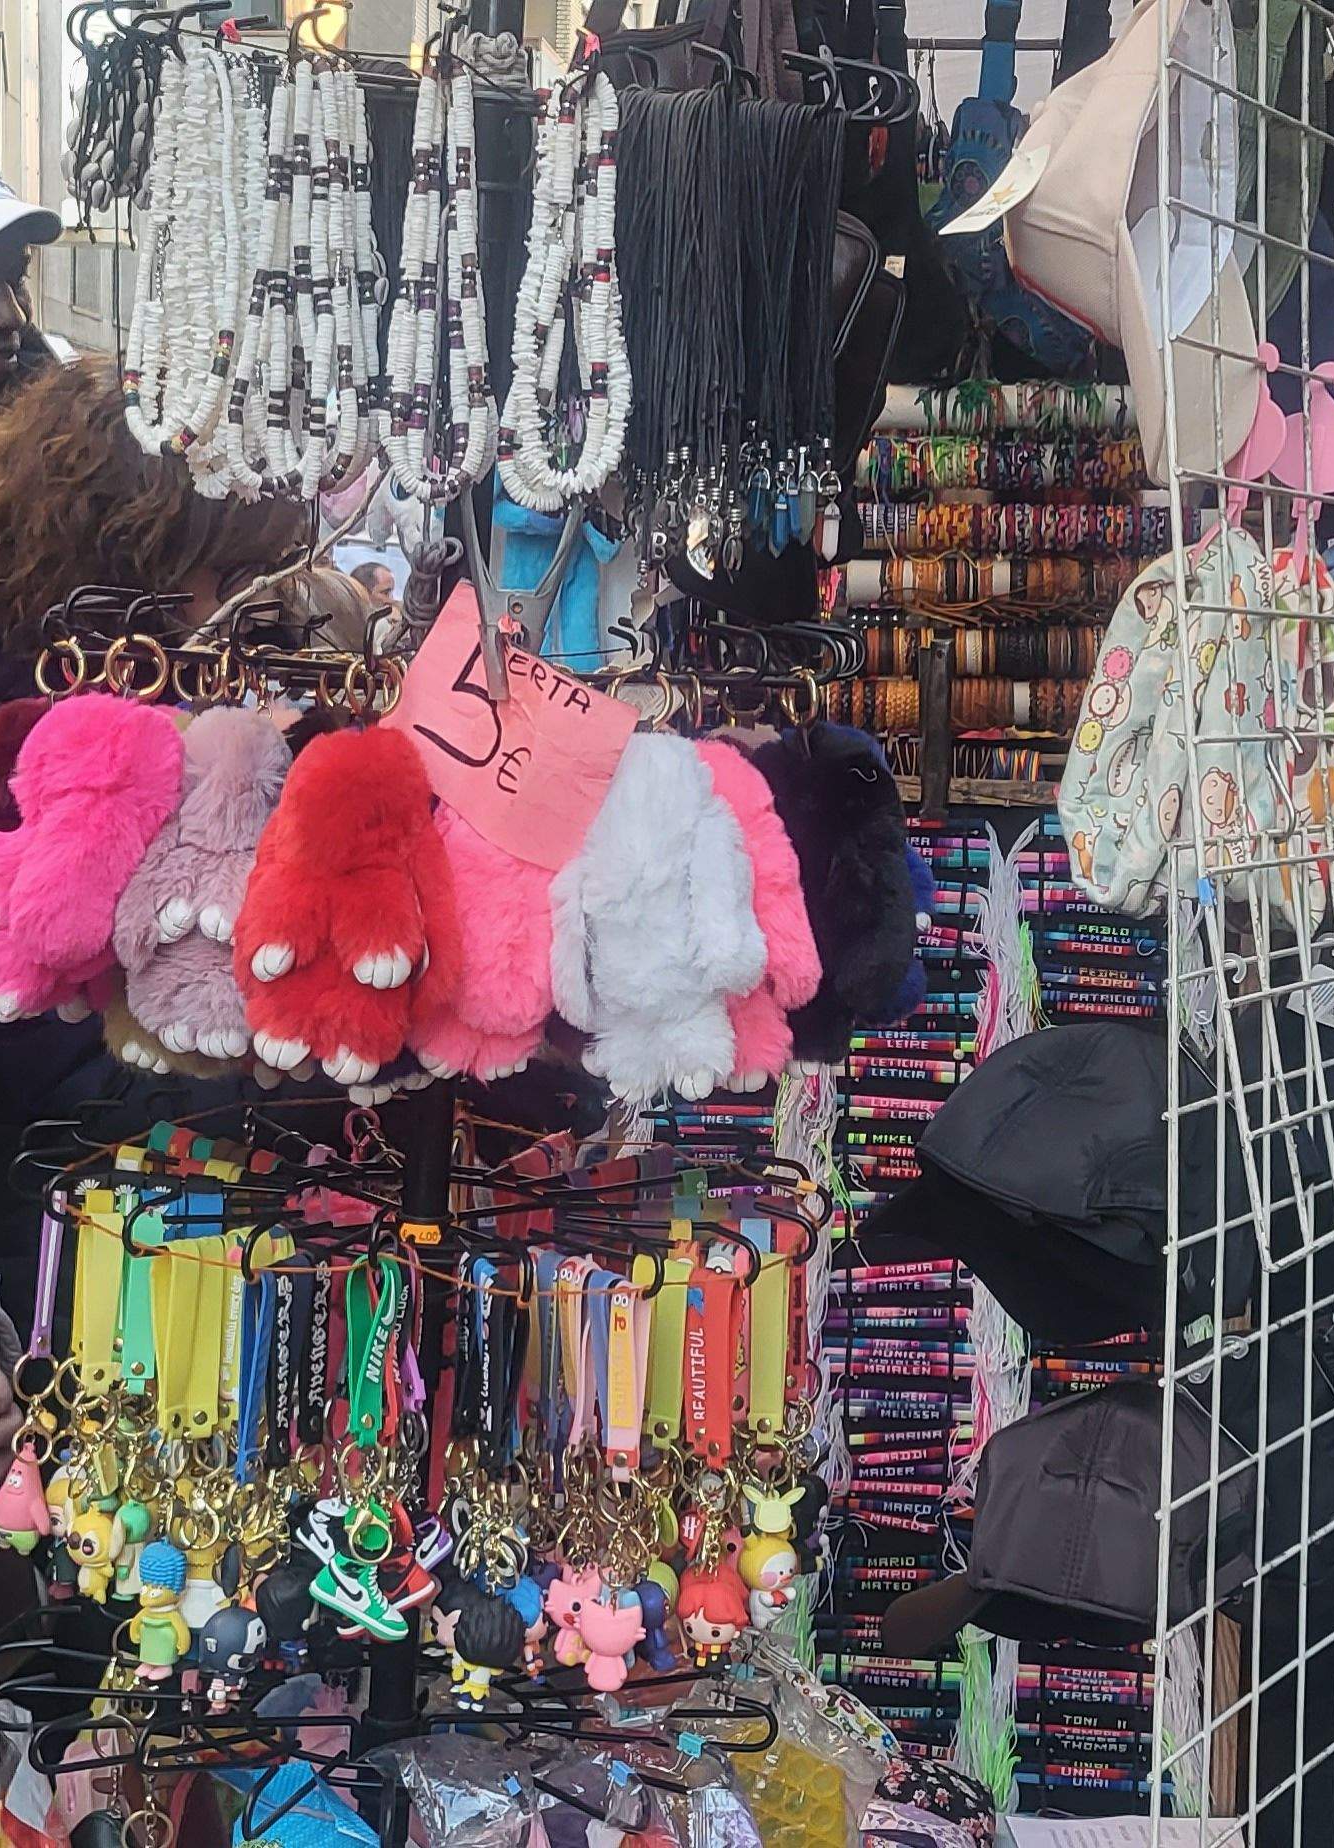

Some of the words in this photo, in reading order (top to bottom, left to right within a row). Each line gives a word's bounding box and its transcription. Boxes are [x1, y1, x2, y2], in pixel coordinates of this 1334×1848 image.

[505, 652, 592, 715] ERTA
[413, 642, 503, 768] 5
[1078, 924, 1130, 936] PABLO
[1071, 942, 1124, 954] PABLO
[1080, 976, 1134, 989] PEDRO
[1069, 992, 1136, 1004] PATRICIO
[1074, 1003, 1141, 1015] PATRICIO
[878, 1031, 919, 1040] LEIRE
[887, 1040, 929, 1050] LEIRE
[871, 1057, 924, 1069] LETICIA
[871, 1068, 926, 1079] LETICIA
[871, 1098, 931, 1110] LORENA
[891, 1110, 935, 1120] LOREN
[873, 1134, 914, 1145] MIKEL
[885, 1262, 933, 1275] MARIA
[879, 1281, 921, 1292] MAITE
[365, 1325, 389, 1384] NIKE
[865, 1364, 931, 1375] MAIALEN
[1085, 1362, 1124, 1372] SAUL
[1071, 1372, 1111, 1383] SAUL
[885, 1391, 927, 1402] MIREN
[876, 1400, 936, 1410] MELISSA
[881, 1408, 940, 1420] MELISSA
[885, 1430, 942, 1442] MARINA
[859, 1466, 915, 1478] MAIDER
[864, 1482, 924, 1493] MAIDER
[868, 1556, 916, 1568] MARIO
[868, 1569, 917, 1580] MARIO
[861, 1581, 912, 1592] MATEO
[1061, 1667, 1108, 1679] TANIA
[864, 1675, 910, 1688] NEREA
[1052, 1690, 1114, 1702] TERESA
[1063, 1714, 1099, 1727] TONI
[1061, 1740, 1128, 1752] THOMAS
[1060, 1766, 1101, 1778] UNAI
[1072, 1777, 1109, 1788] UNAI
